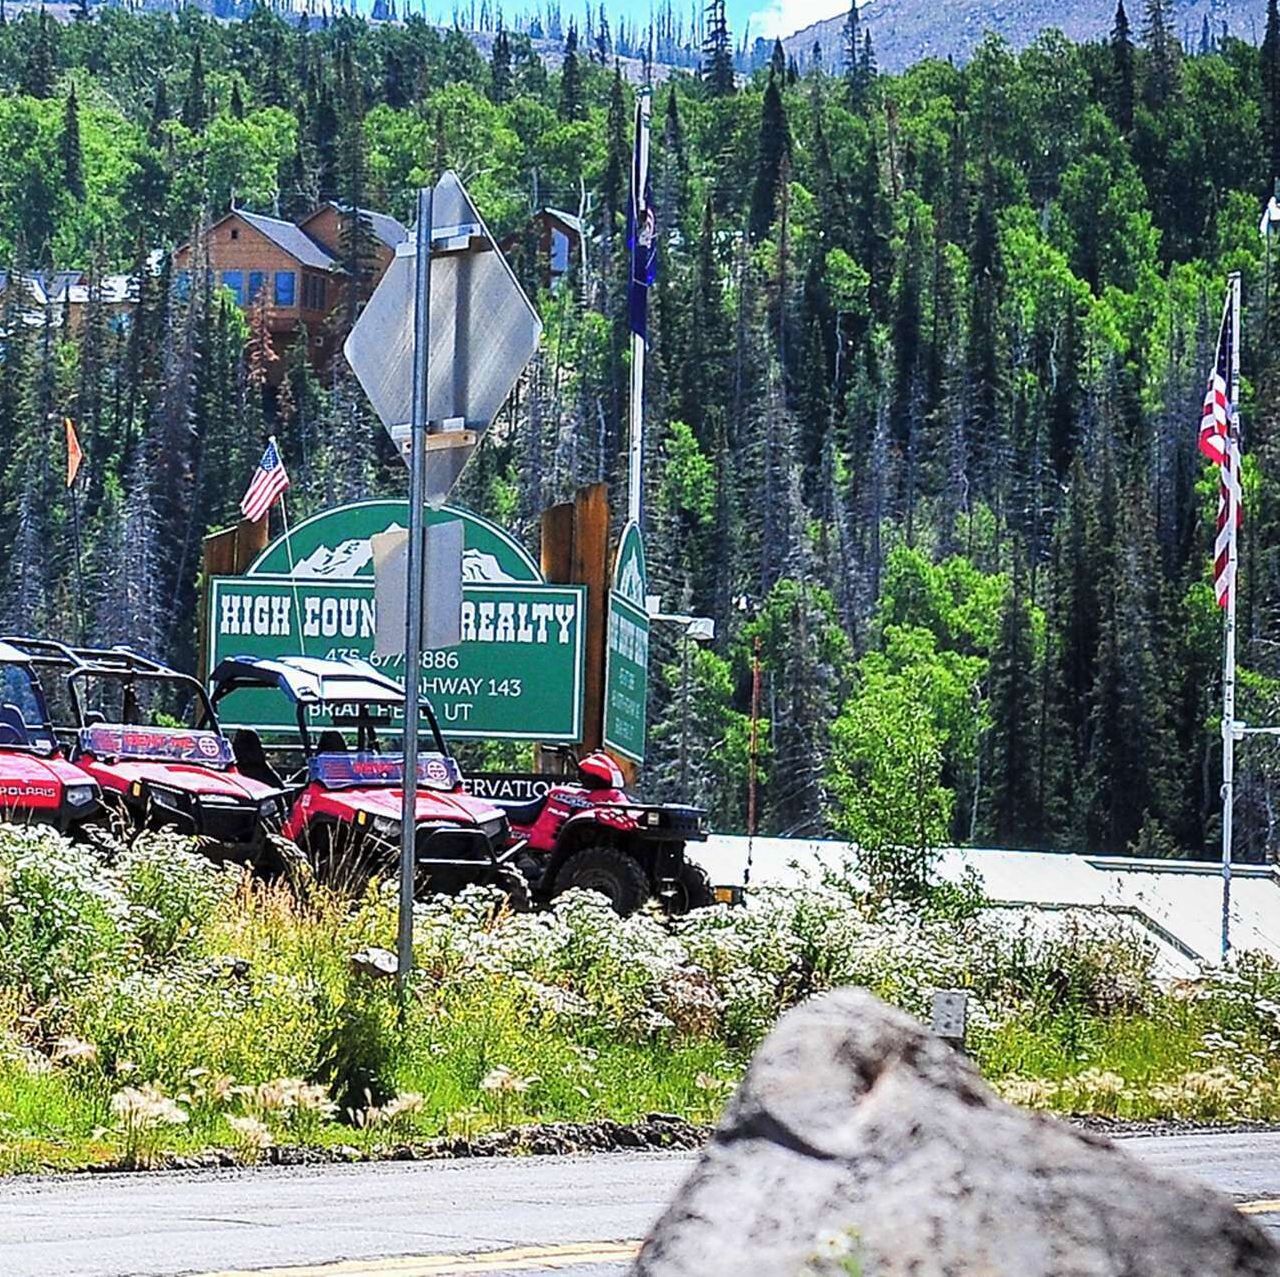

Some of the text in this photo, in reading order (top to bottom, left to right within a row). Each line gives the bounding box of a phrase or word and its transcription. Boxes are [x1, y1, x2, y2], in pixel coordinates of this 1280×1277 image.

[219, 594, 292, 637] HIGH
[460, 601, 576, 645] REALTY
[488, 679, 522, 697] 143
[444, 703, 474, 721] UT
